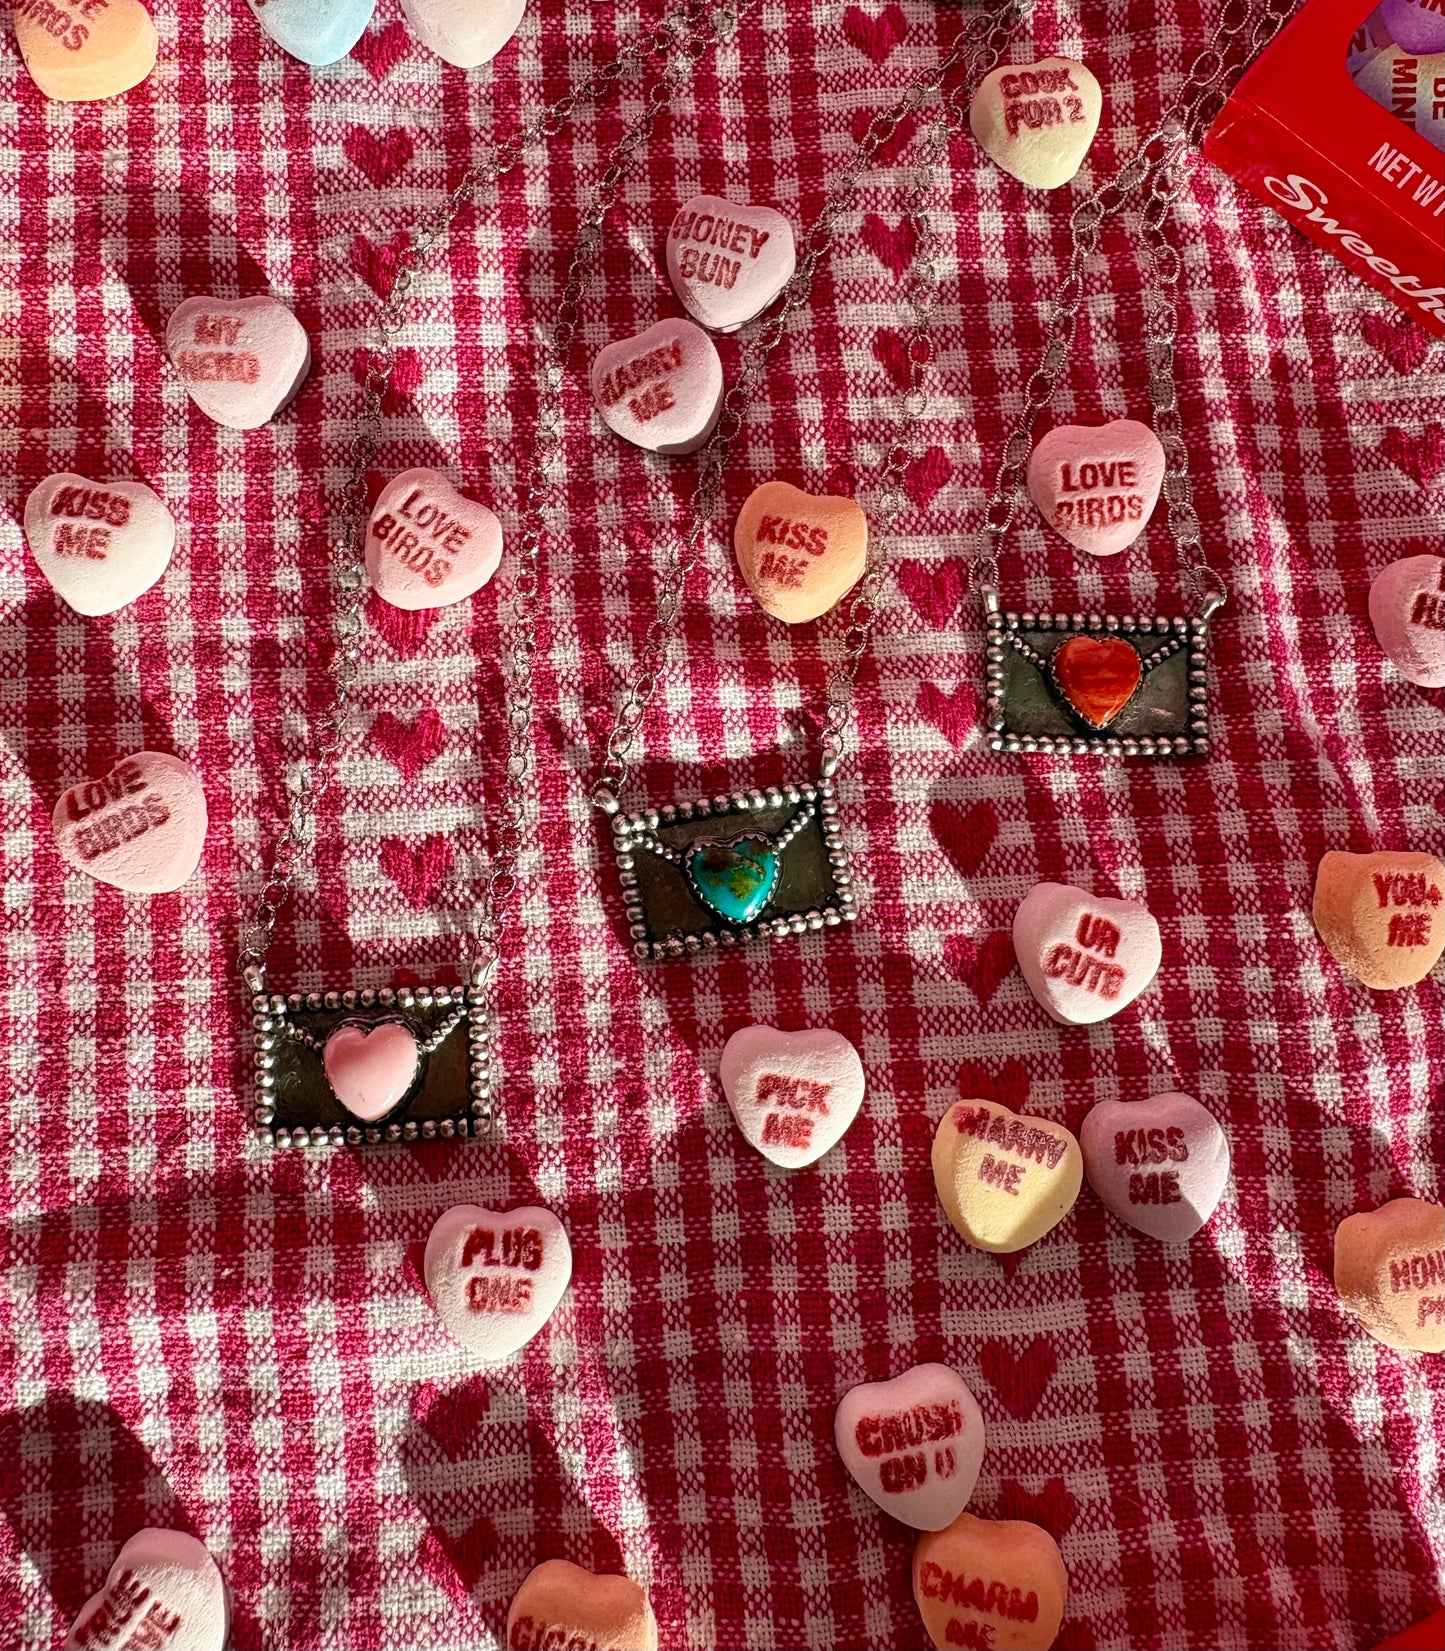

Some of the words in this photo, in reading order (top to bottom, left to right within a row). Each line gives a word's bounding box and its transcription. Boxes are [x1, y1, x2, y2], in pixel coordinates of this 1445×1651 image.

[1063, 94, 1086, 124] 2
[1392, 58, 1418, 130] MIN
[1367, 142, 1423, 189] NET
[672, 211, 770, 259] HONEY
[679, 248, 741, 289] BUN
[628, 381, 676, 423] ME
[1060, 461, 1137, 492] LOVE
[51, 486, 131, 527] KISS
[399, 489, 472, 554] LOVE
[1052, 494, 1144, 530] BIRDS
[54, 522, 111, 560] ME
[372, 513, 453, 588] BIRDS
[756, 515, 829, 557] KISS
[759, 551, 810, 588] ME
[66, 761, 149, 822] LOVE
[1076, 913, 1121, 959] UR
[1386, 913, 1433, 948] ME
[1041, 942, 1126, 1001] CUTE
[761, 1113, 816, 1150] ME
[1114, 1126, 1191, 1165] KISS
[977, 1153, 1027, 1197] ME
[1128, 1170, 1183, 1205] ME
[879, 1451, 928, 1495] ON
[920, 1561, 1039, 1624] CHARM
